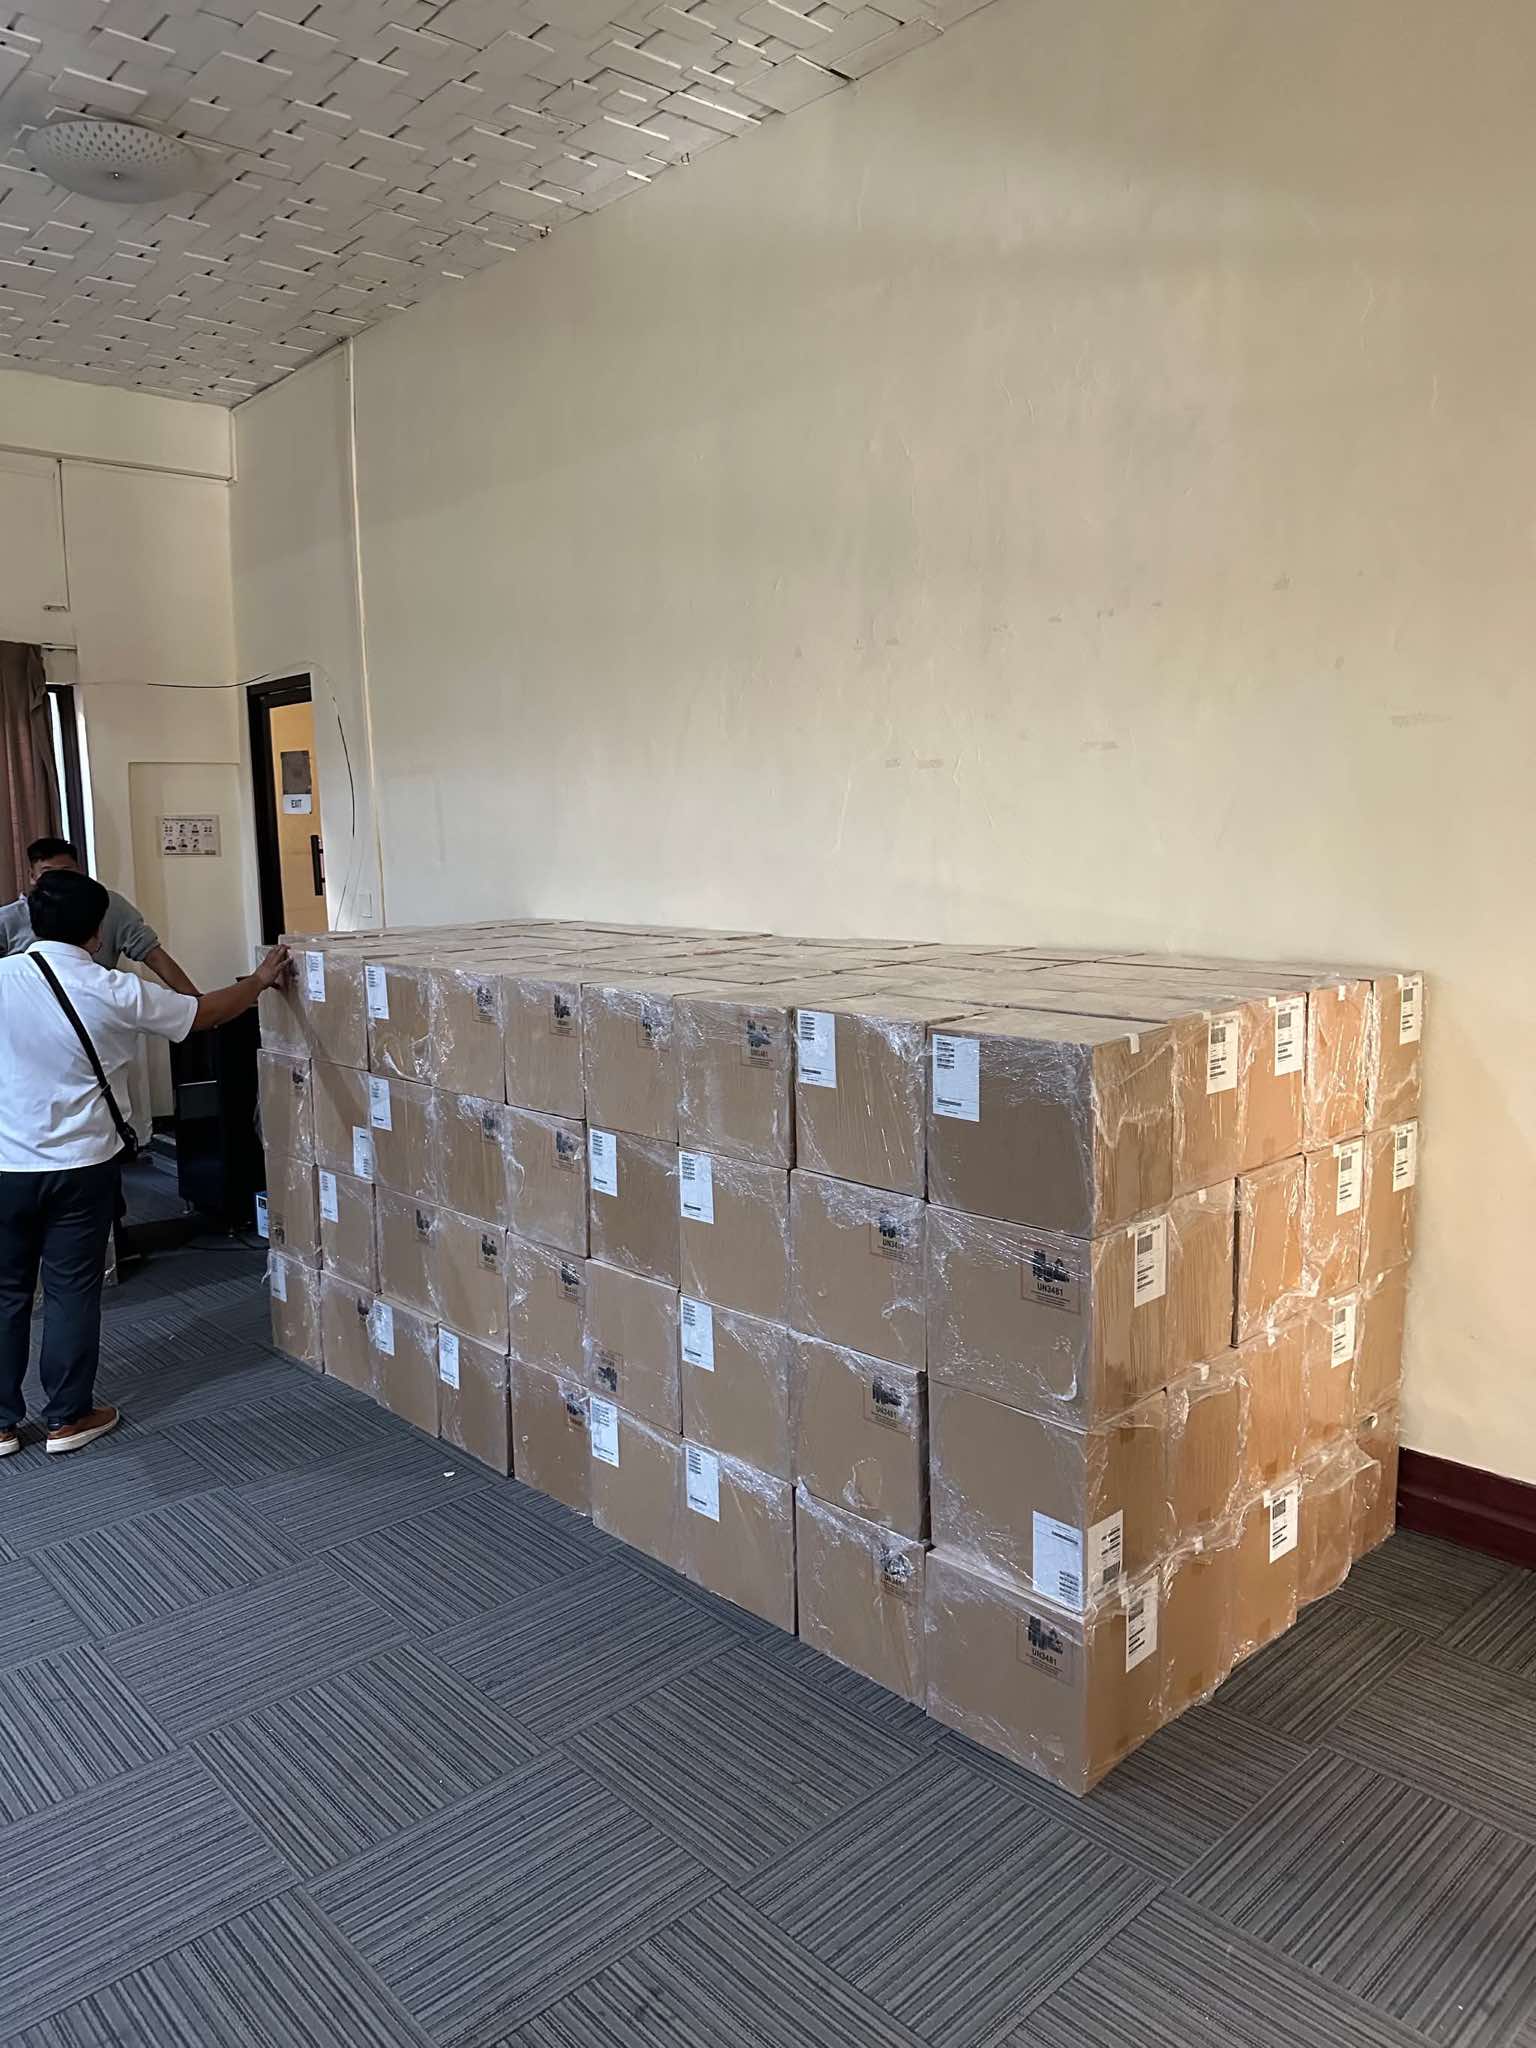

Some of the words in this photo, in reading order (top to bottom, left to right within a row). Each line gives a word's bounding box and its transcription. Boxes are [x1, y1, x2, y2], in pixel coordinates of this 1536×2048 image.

[291, 799, 302, 808] EXIT
[1037, 1282, 1064, 1296] UN3481
[1032, 1649, 1057, 1666] UN3481
